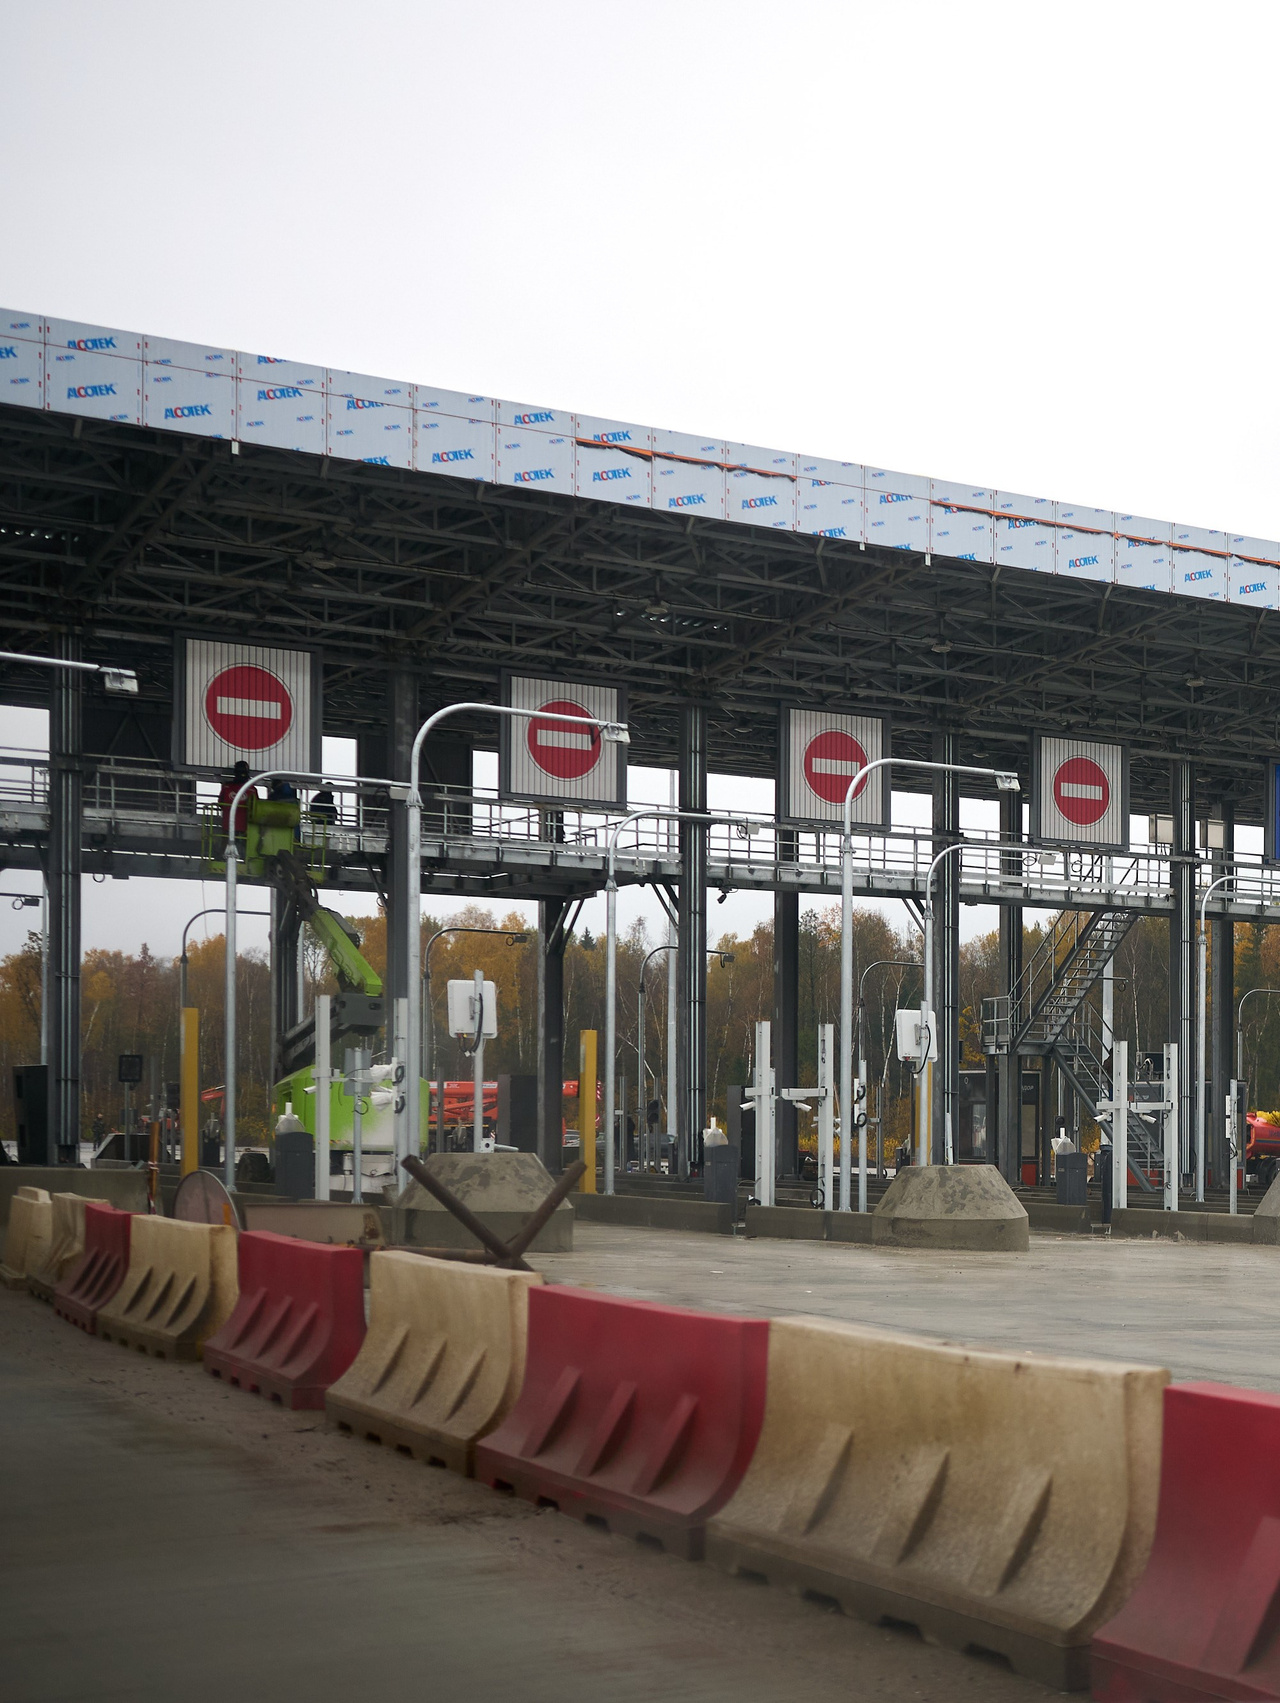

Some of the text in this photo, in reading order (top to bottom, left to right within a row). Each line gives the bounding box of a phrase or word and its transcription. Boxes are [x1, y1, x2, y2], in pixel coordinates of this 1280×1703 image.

[67, 337, 117, 352] ALCOTEK
[67, 384, 116, 401] ALCOTEK
[164, 405, 212, 421] ALCOTEK
[513, 411, 555, 426] ALCOTEK
[432, 449, 474, 464] ALCOTEK
[513, 469, 554, 485] ALCOTEK
[592, 468, 632, 483] ALCOTEK
[668, 494, 706, 510] ALCOTEK
[741, 497, 778, 510] ALCOTEK
[1069, 556, 1099, 569] ALCOTEK
[1184, 570, 1213, 583] ALCOTEK
[1239, 583, 1266, 595] ALCOTEK
